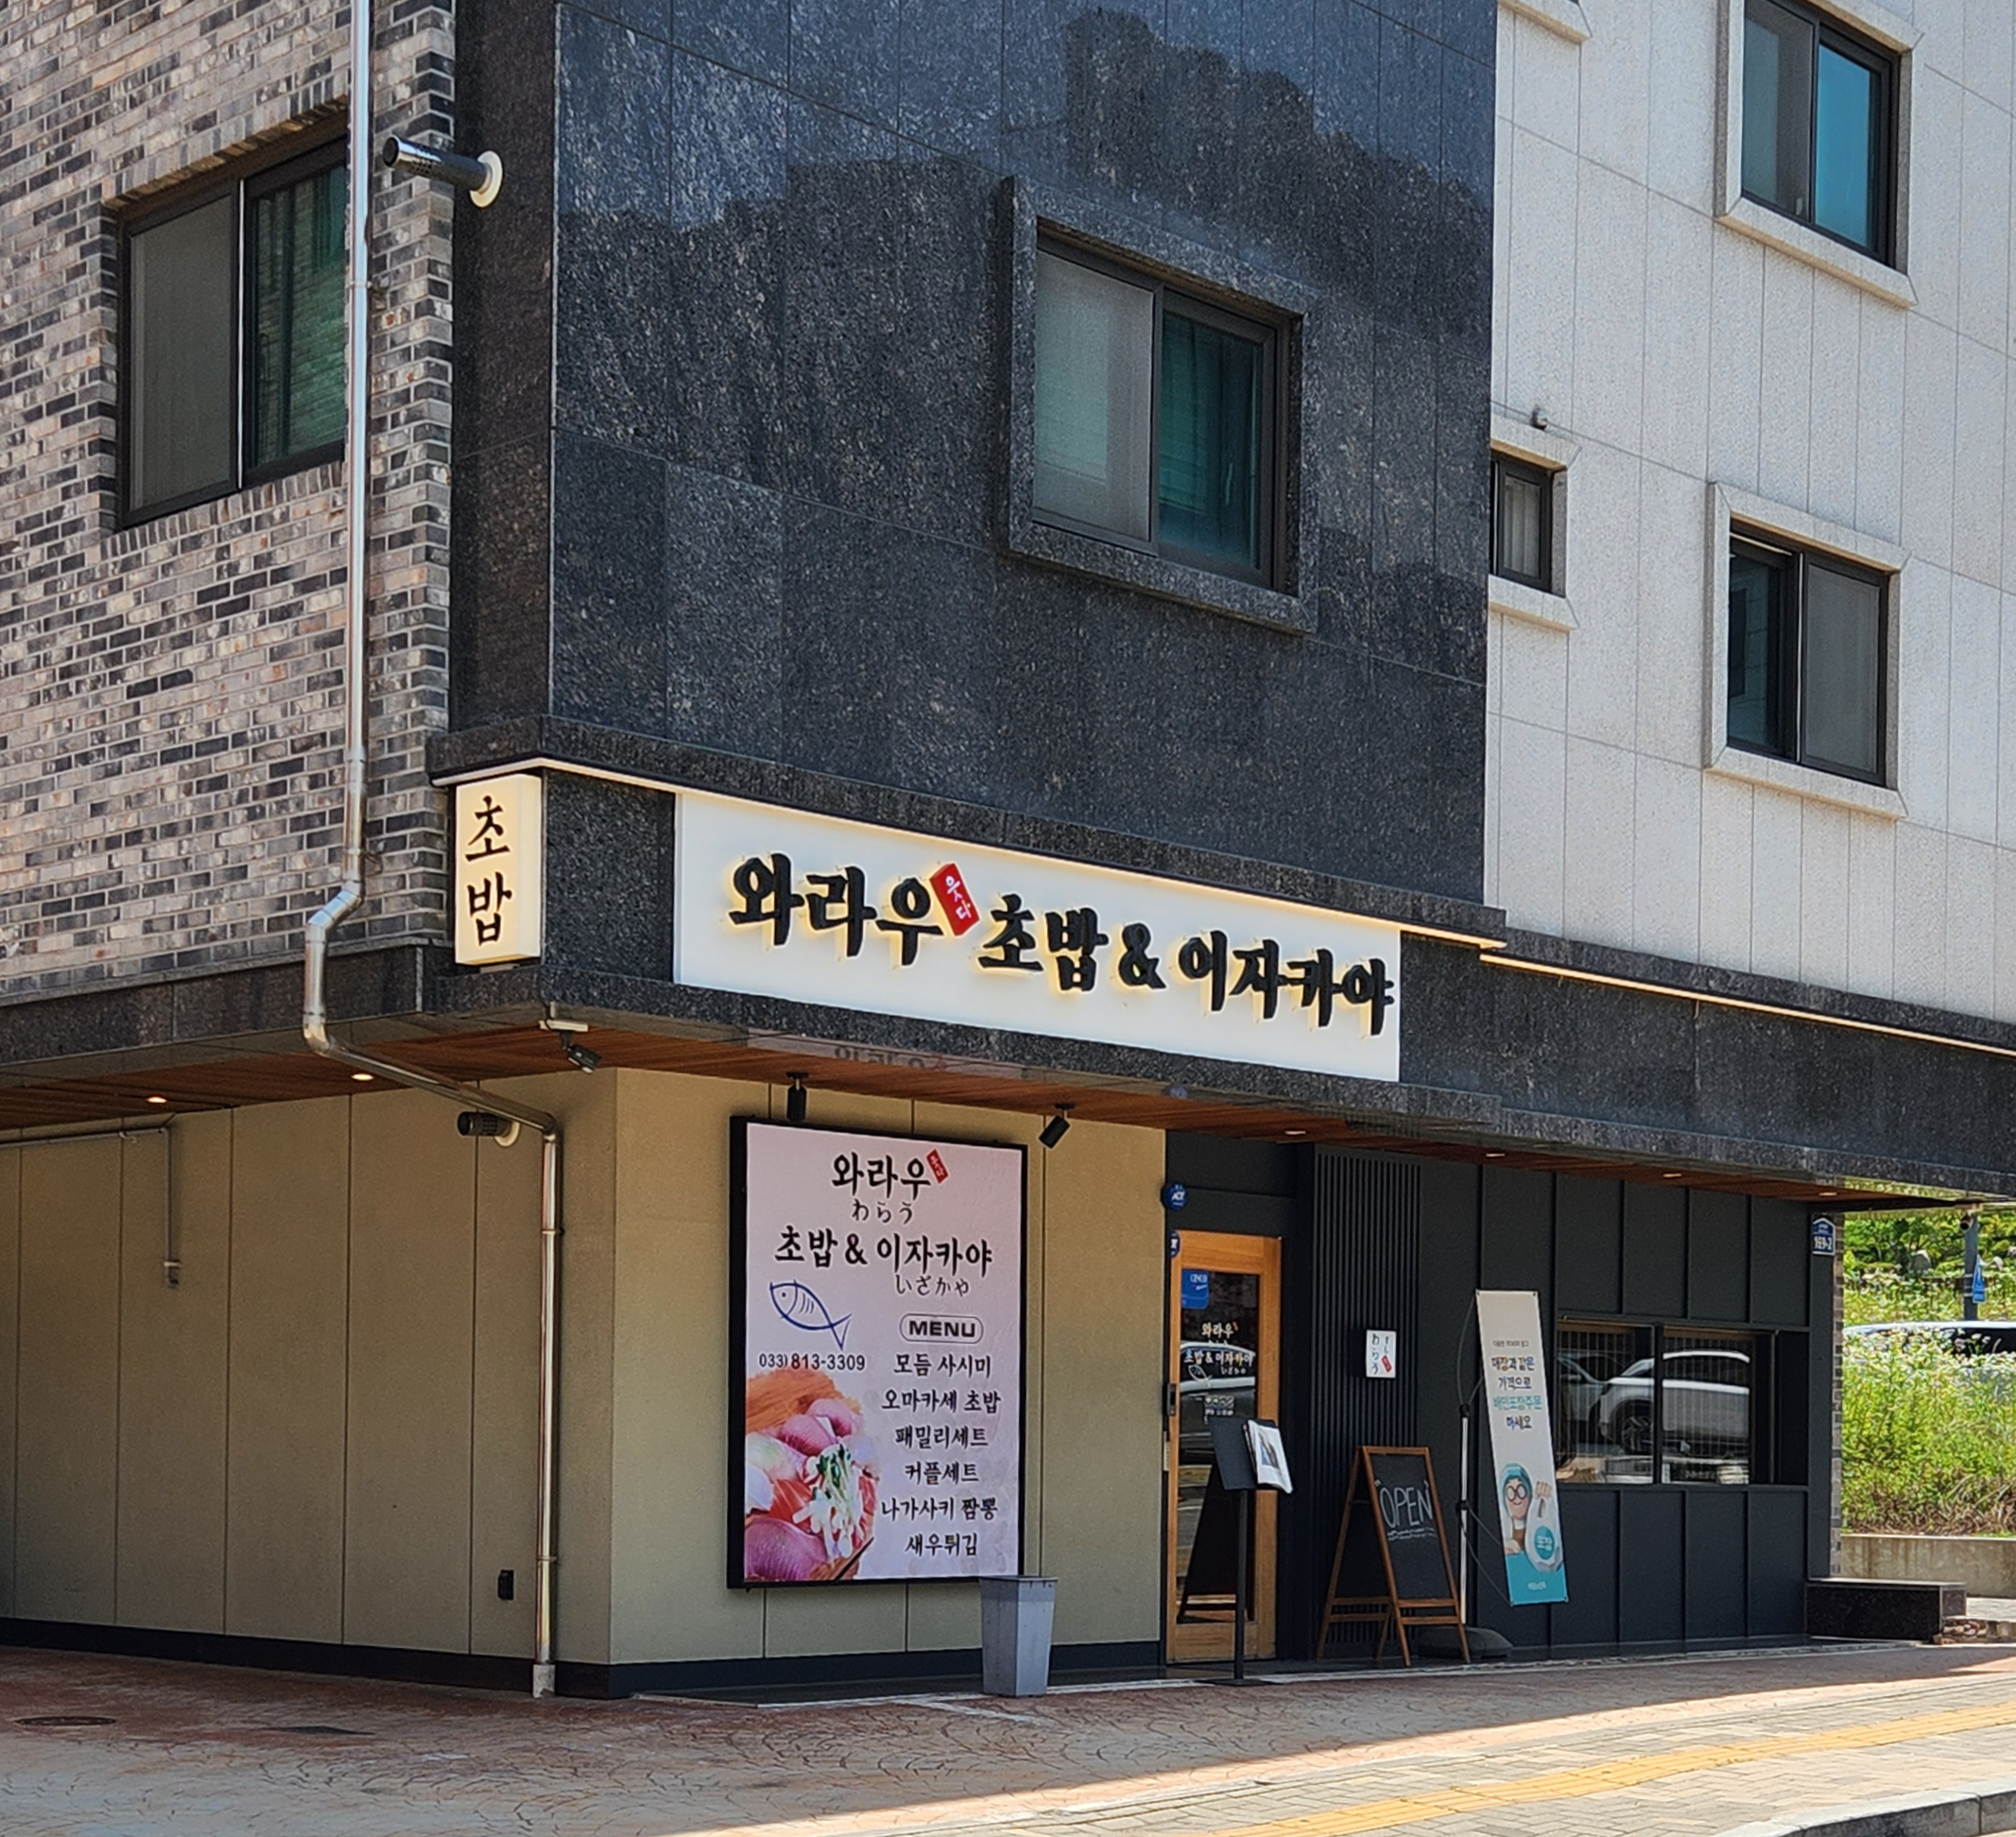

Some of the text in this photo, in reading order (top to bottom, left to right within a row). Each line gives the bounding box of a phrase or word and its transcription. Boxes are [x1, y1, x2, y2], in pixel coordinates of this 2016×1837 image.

[465, 795, 511, 946] 초밥
[728, 852, 944, 966] 와라우
[977, 893, 1110, 992] 초밥
[1178, 930, 1396, 1036] 이자카야
[832, 1151, 931, 1201] 와라우
[852, 1198, 914, 1225] わらう
[774, 1225, 839, 1268] 초밥
[876, 1232, 993, 1278] 이자카야
[895, 1274, 970, 1297] いざかや
[908, 1320, 975, 1338] MENU
[759, 1352, 866, 1371] 033) 813-3309
[893, 1353, 991, 1379] 모듬 사시미
[881, 1388, 1002, 1415] 오마카세 초밥
[895, 1424, 989, 1450] 패밀리세트
[905, 1461, 979, 1486] 커플세트
[881, 1496, 998, 1522] 나가사키 짬뽕
[905, 1532, 977, 1558] 새우튀김
